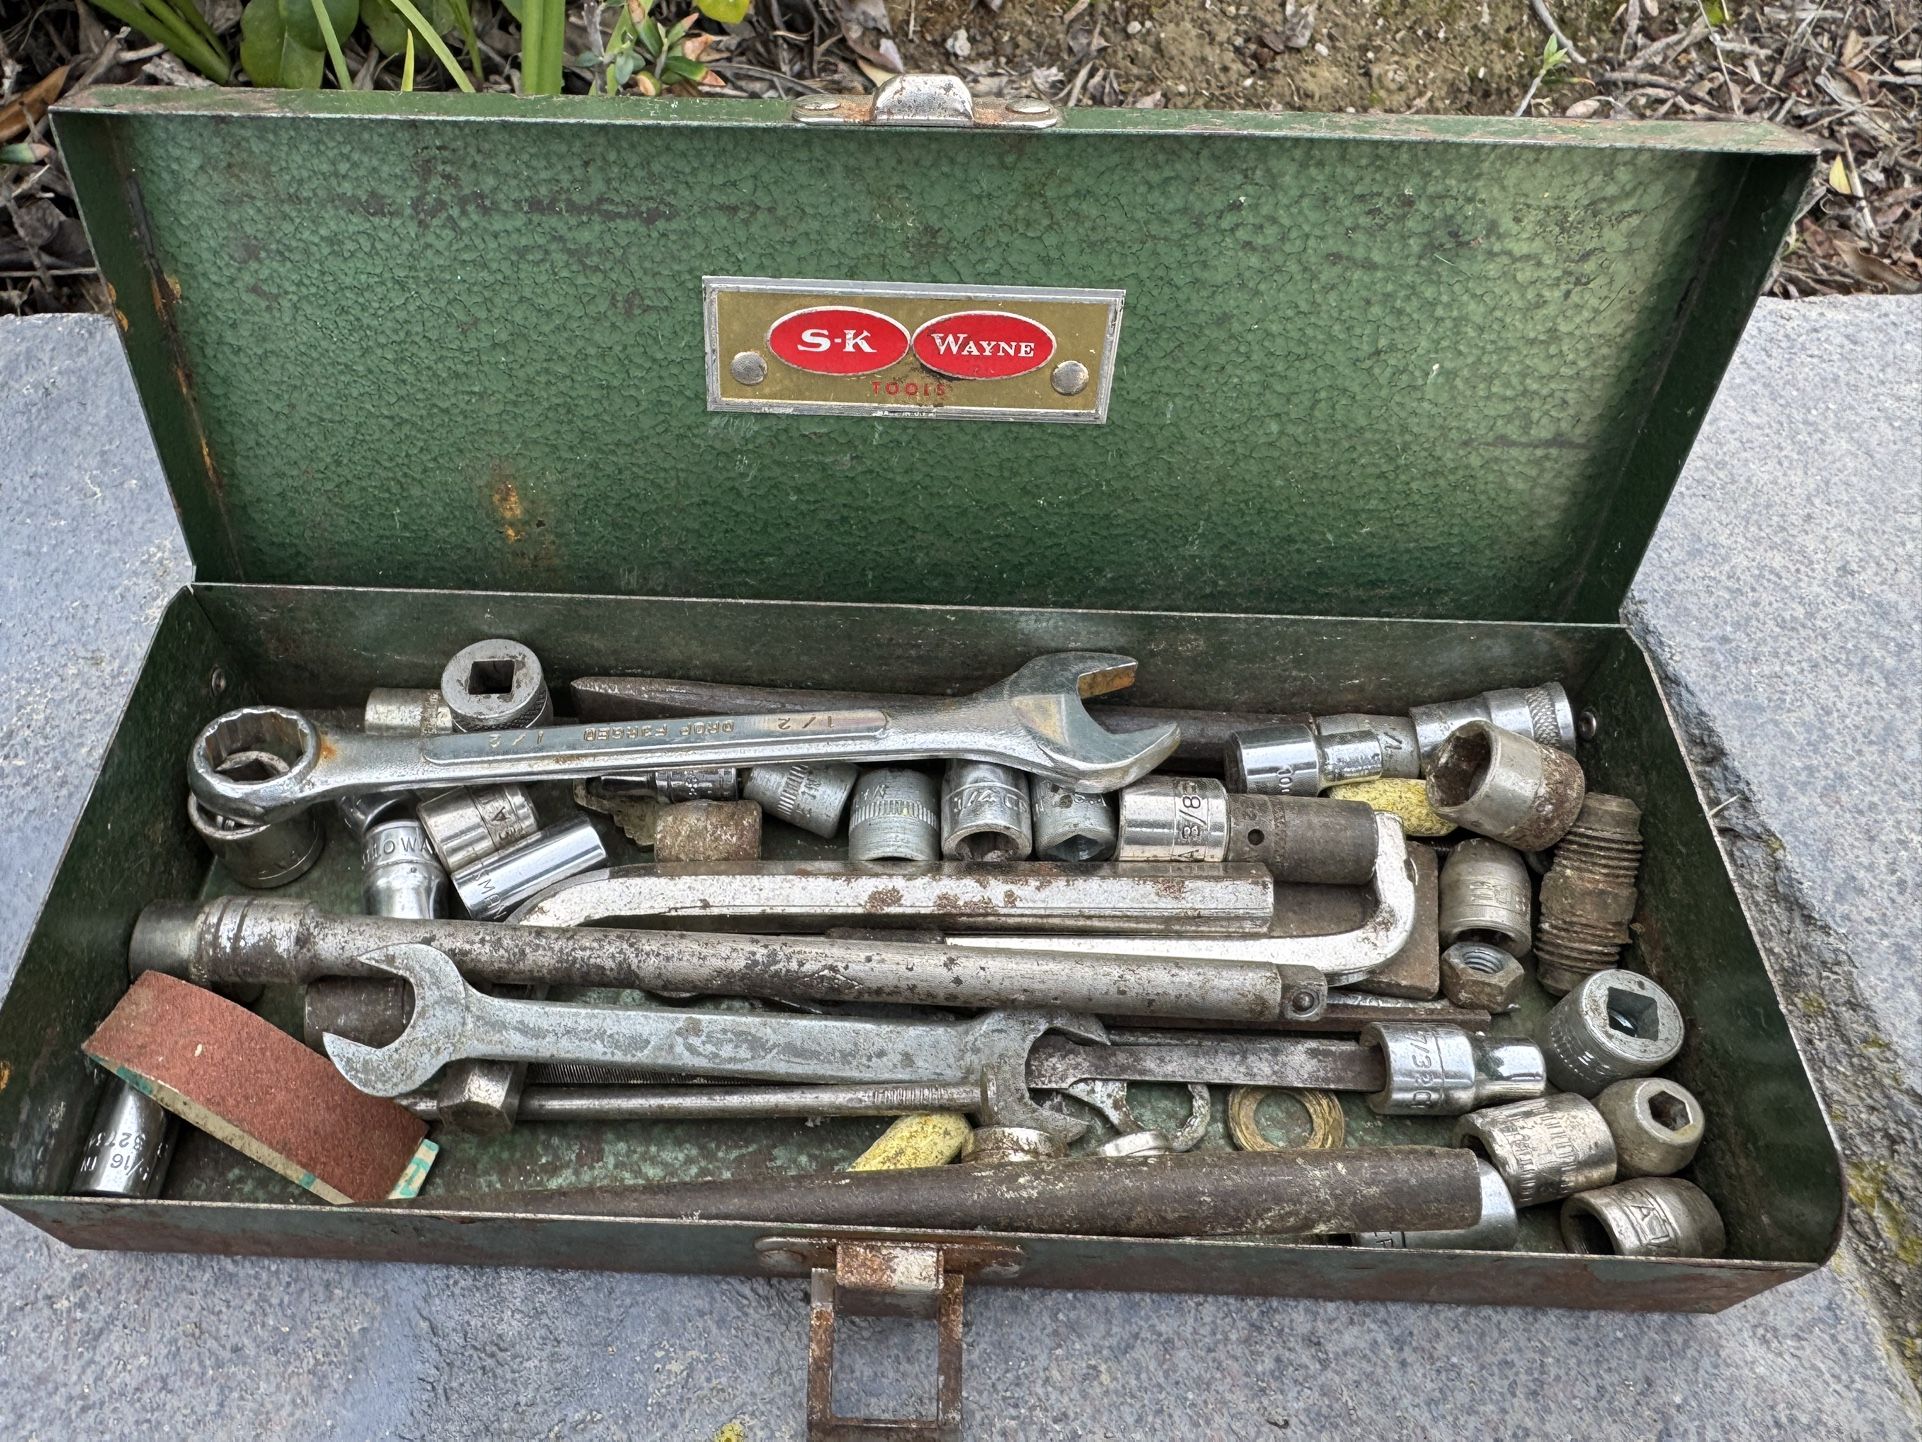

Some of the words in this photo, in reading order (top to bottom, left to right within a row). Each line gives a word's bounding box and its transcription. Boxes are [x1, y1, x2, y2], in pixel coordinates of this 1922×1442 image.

[797, 328, 877, 353] S-K
[931, 333, 1035, 358] WAYNE
[872, 381, 946, 397] TOOLS
[680, 719, 736, 735] DROP
[777, 715, 835, 731] 1/2
[488, 731, 545, 749] 1/2
